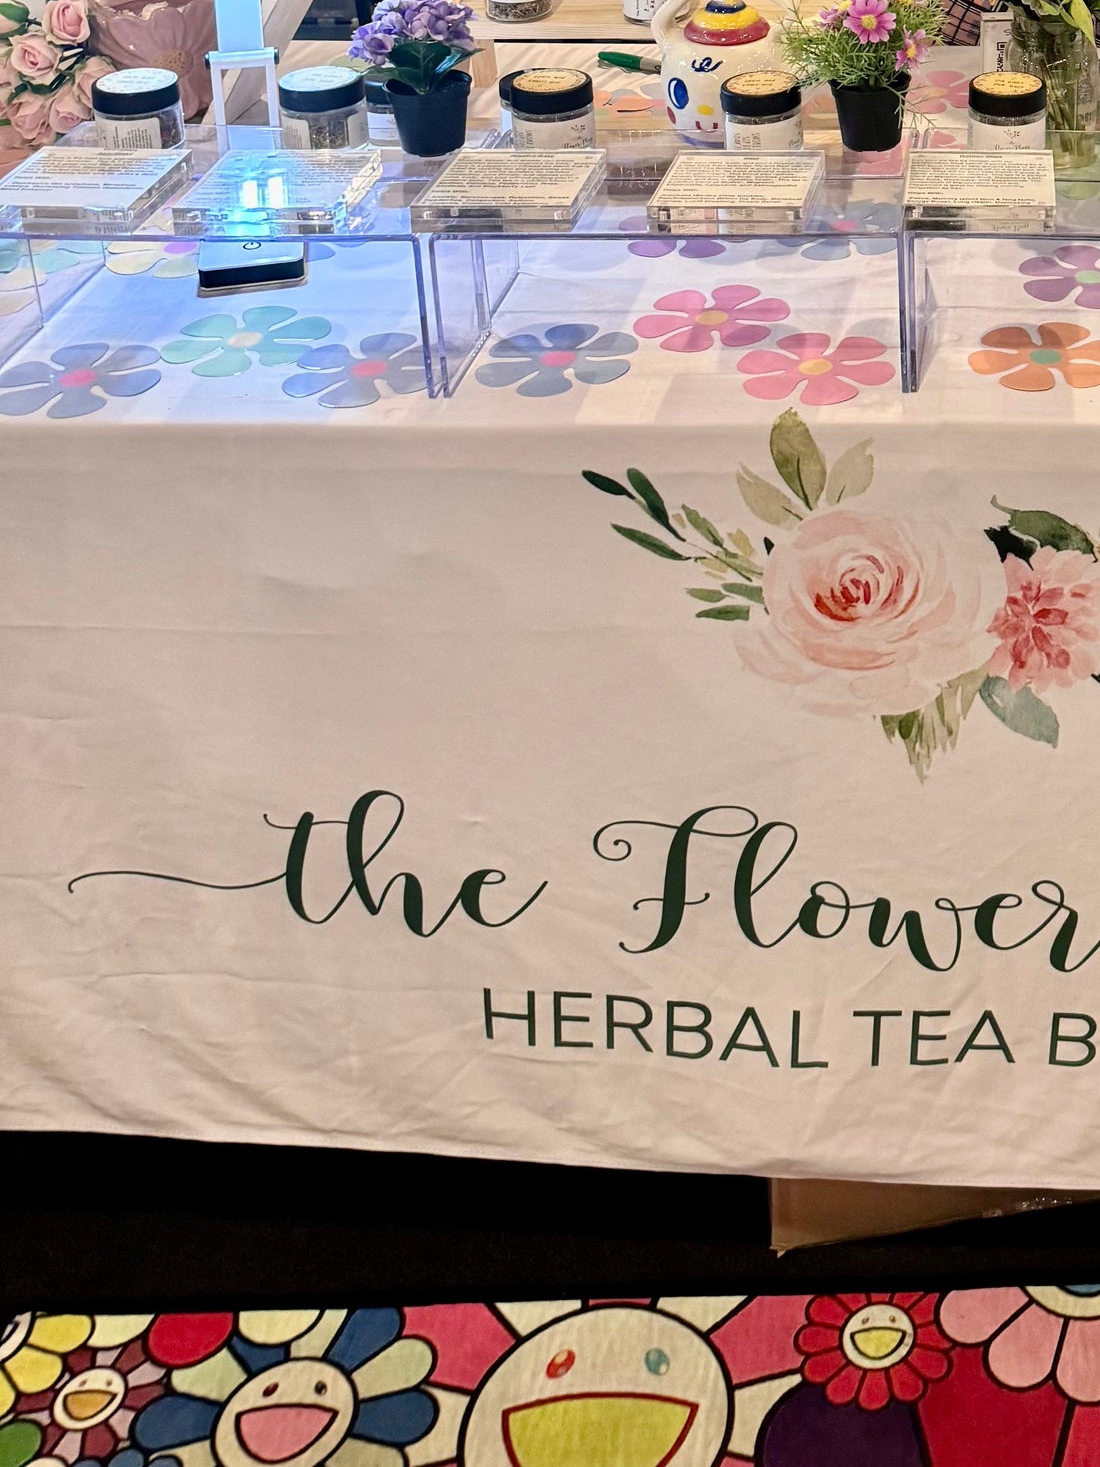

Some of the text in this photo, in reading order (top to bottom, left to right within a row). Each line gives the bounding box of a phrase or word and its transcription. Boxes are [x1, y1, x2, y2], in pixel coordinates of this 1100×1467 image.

[68, 790, 548, 936] the
[482, 987, 829, 1069] HERBAL
[853, 1008, 1016, 1066] TEA
